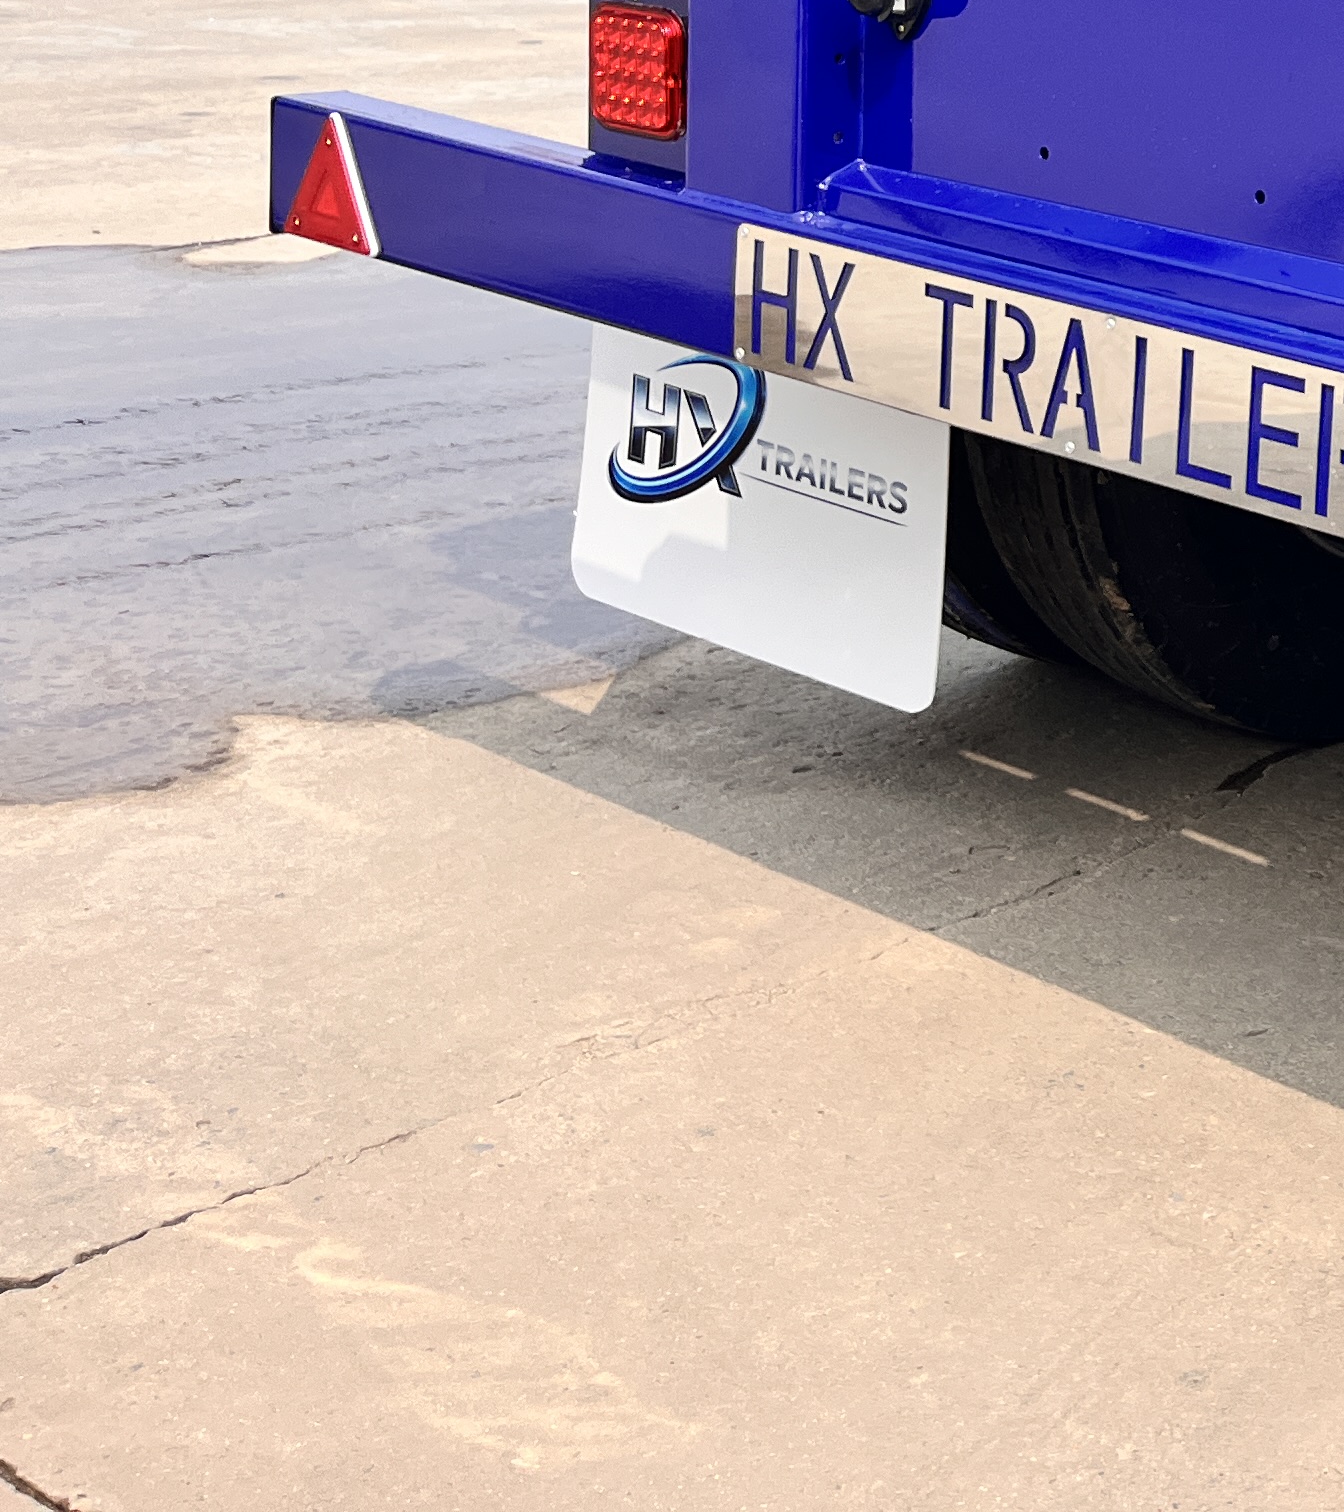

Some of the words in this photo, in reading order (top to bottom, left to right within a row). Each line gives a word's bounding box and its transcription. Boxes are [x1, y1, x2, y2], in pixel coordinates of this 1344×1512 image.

[751, 239, 855, 382] HX
[625, 368, 750, 499] HX
[755, 437, 909, 515] TRAILERS
